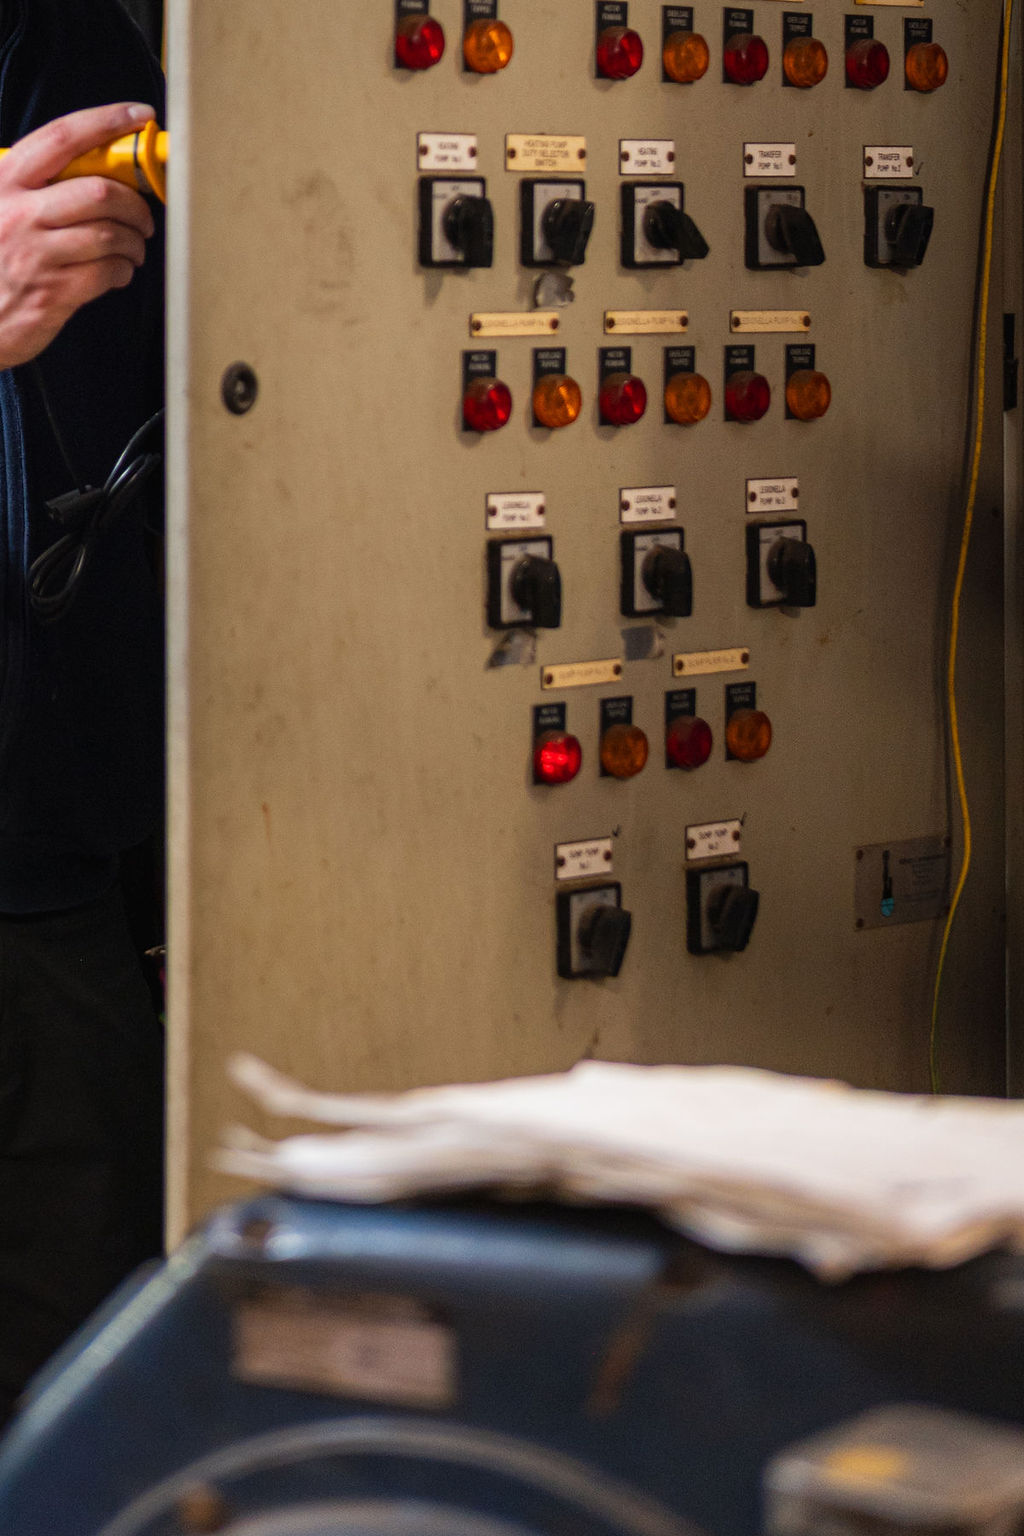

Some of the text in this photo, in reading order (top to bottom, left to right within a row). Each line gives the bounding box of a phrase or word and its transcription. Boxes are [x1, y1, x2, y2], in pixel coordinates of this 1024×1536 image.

[757, 150, 782, 160] TRANSFER
[877, 152, 901, 162] TRANSFER
[757, 162, 772, 171] PUMP
[876, 164, 890, 173] PUMP
